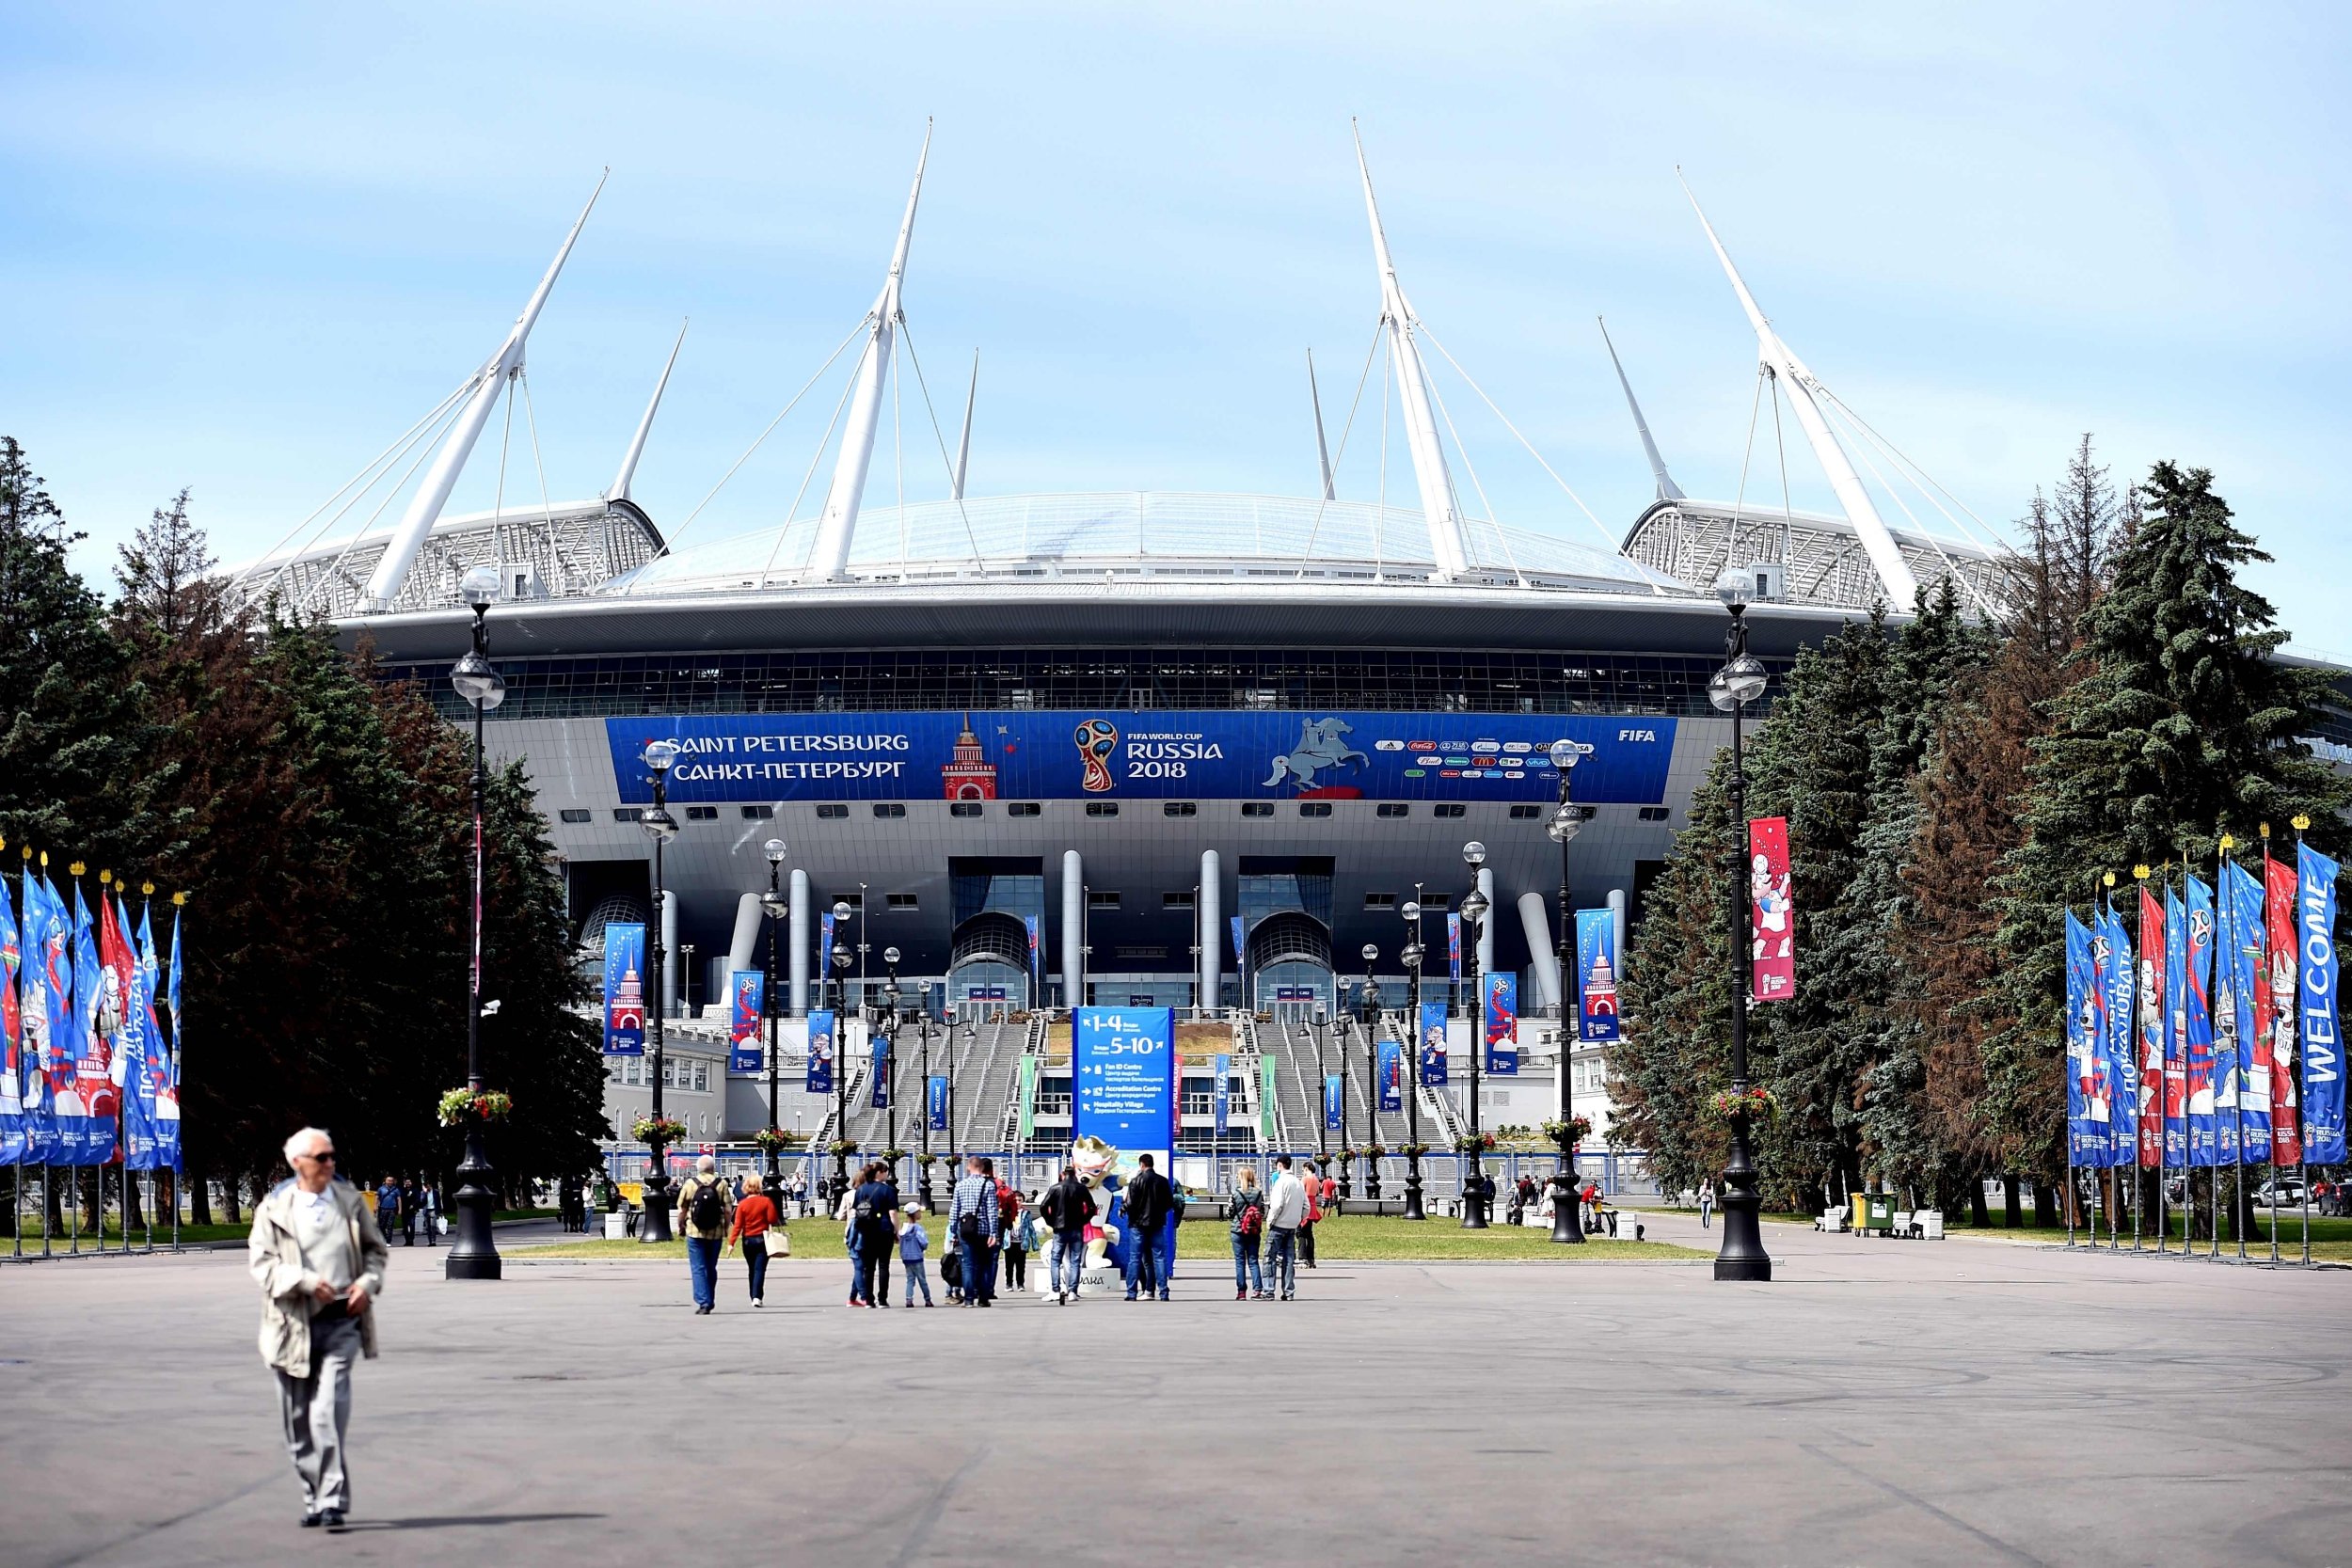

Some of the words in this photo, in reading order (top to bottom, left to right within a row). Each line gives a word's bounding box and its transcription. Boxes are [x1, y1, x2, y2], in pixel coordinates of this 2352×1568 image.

[665, 737, 738, 753] SAINT
[744, 735, 910, 752] PETERSBURG
[1618, 729, 1656, 742] FIFA
[1127, 743, 1224, 759] RUSSIA
[674, 762, 906, 781] САНКТ-ПЕТЕРБУРГ
[1127, 761, 1187, 778] 2018
[2305, 873, 2338, 1083] WELCOME
[1110, 1037, 1153, 1054] 5-10
[1217, 1070, 1228, 1100] FIFA
[1093, 1101, 1124, 1109] Hospitality
[2316, 1129, 2341, 1137] RUSSIA
